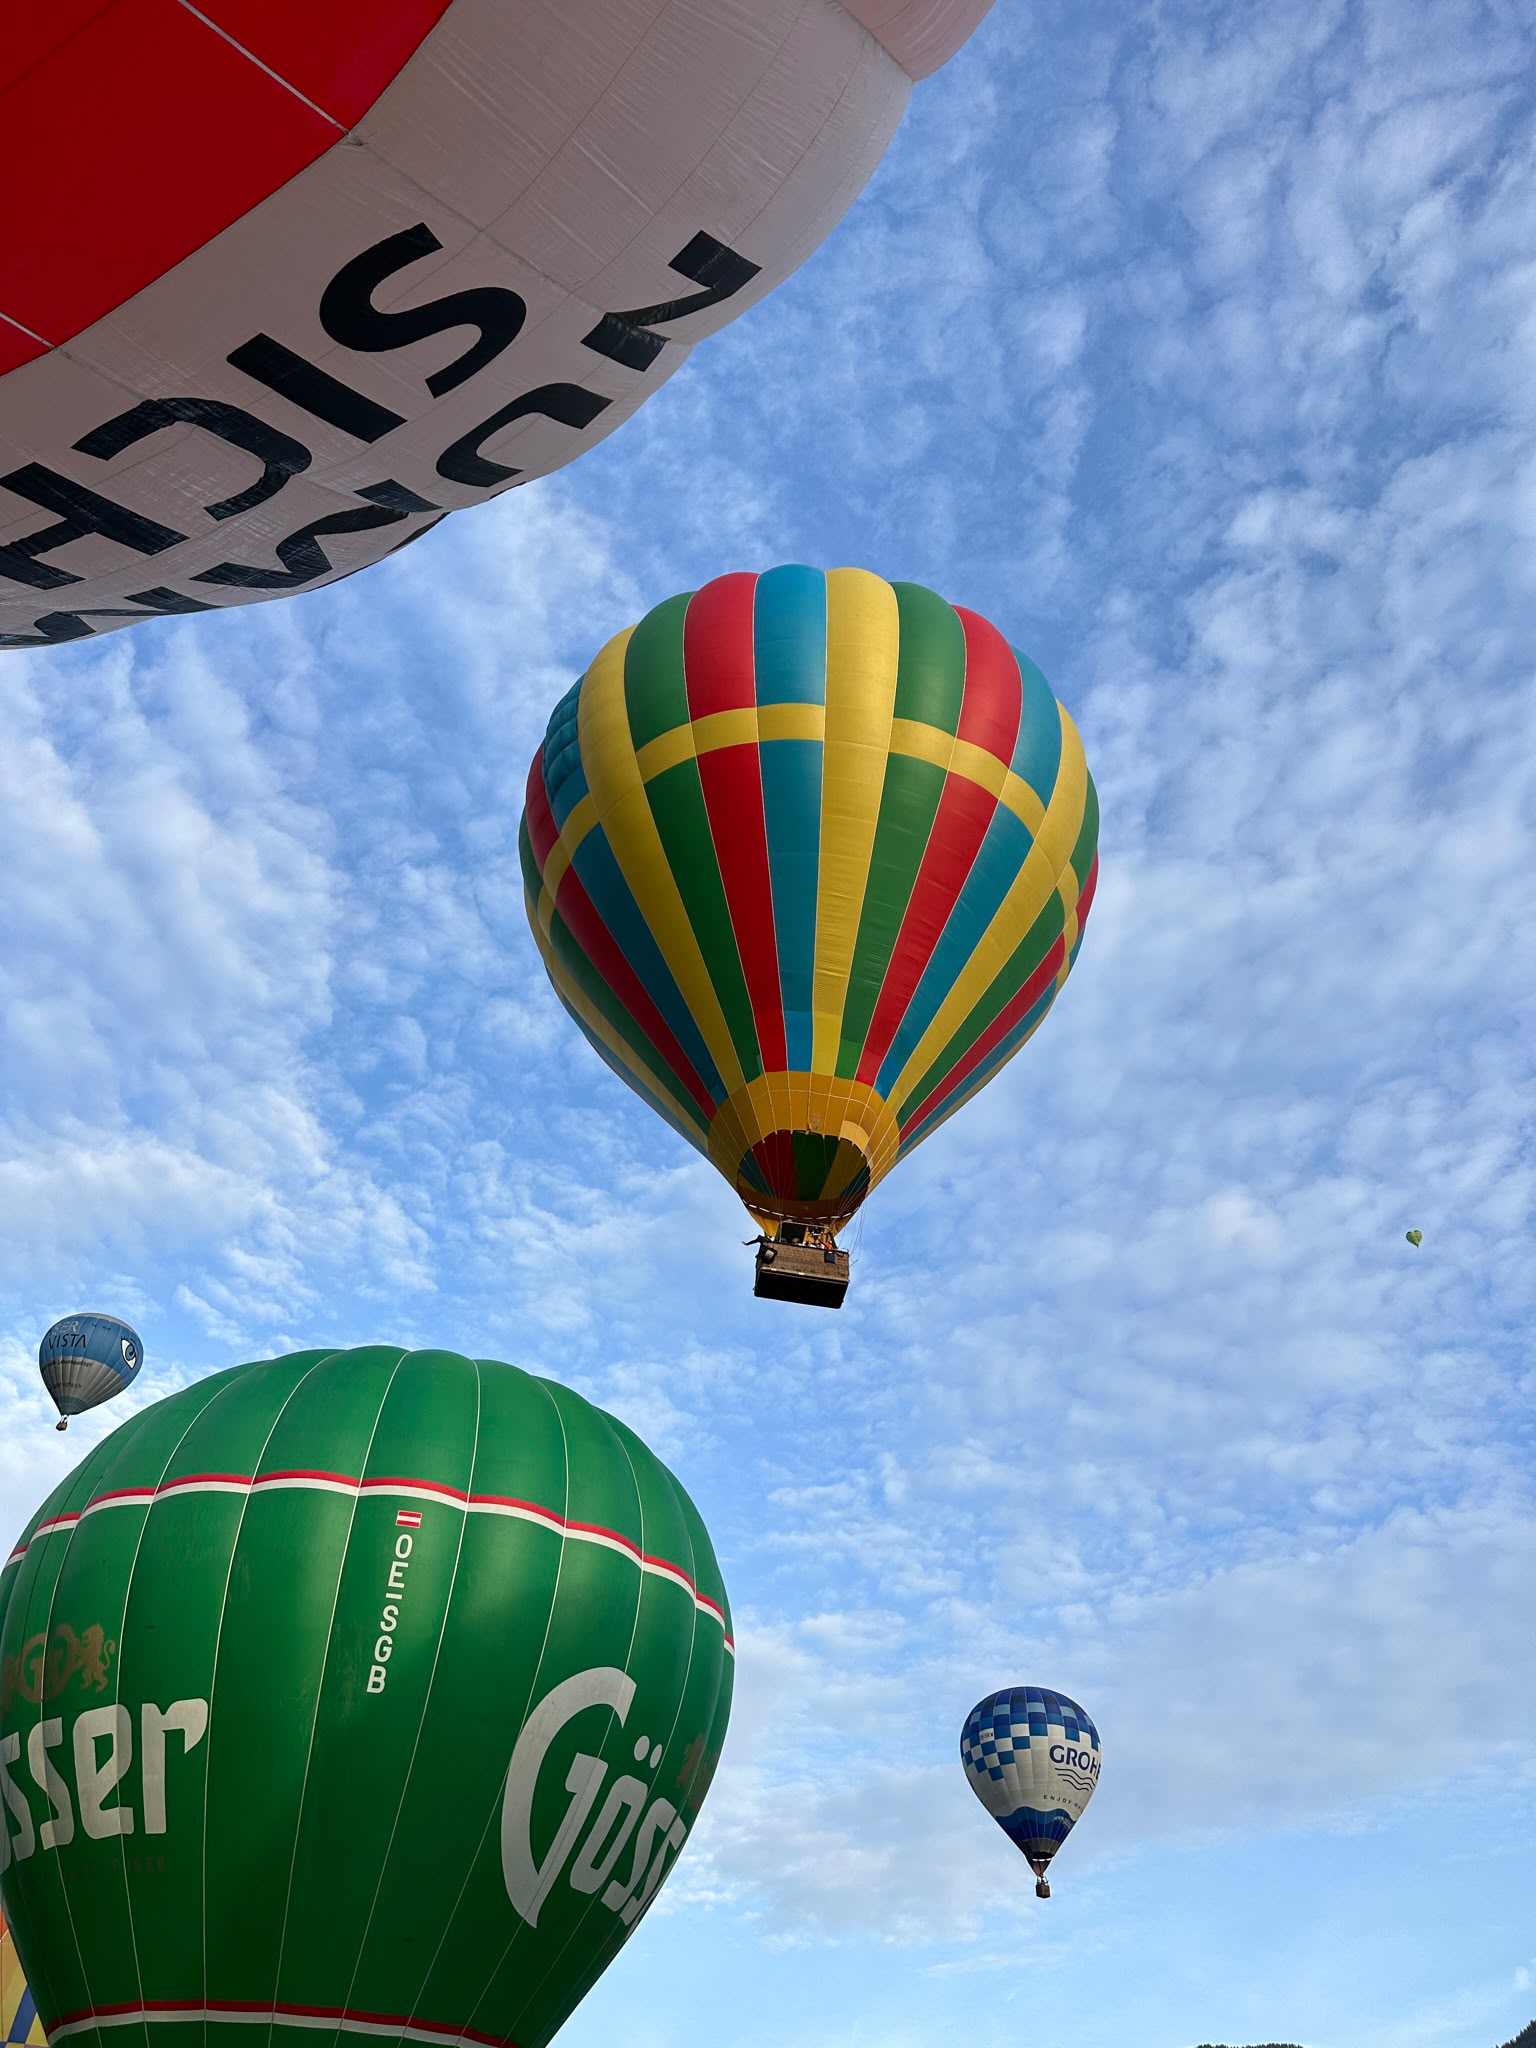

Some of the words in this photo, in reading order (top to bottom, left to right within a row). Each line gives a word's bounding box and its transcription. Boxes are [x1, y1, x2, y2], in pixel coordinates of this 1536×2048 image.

[366, 1533, 413, 1694] OE-SGB
[0, 1698, 209, 1875] sser
[501, 1666, 688, 1936] Göss
[1043, 1794, 1072, 1804] ENJOY
